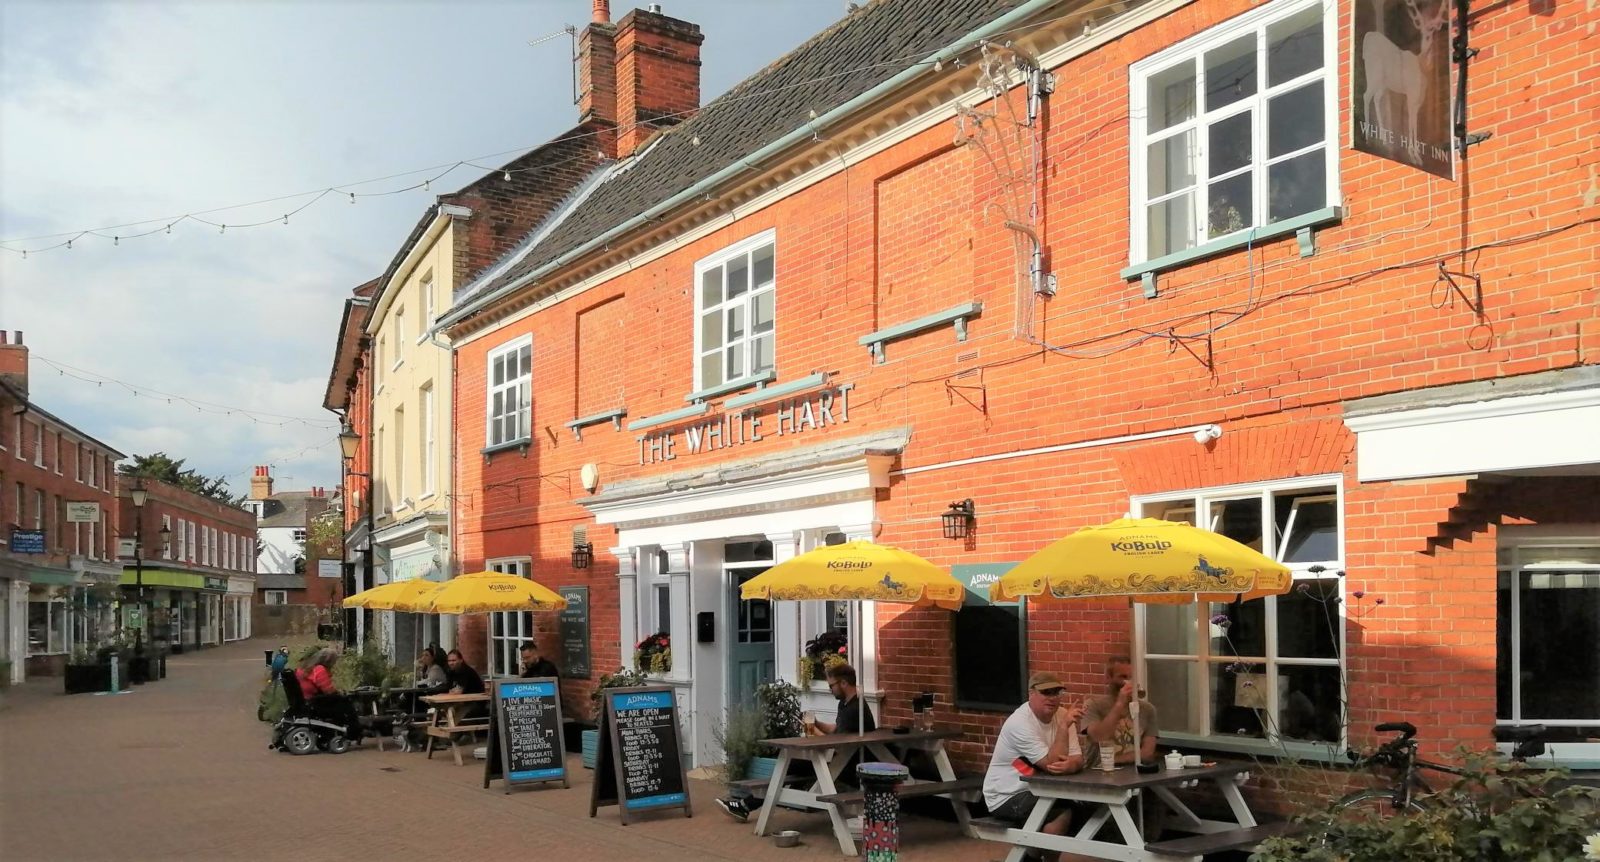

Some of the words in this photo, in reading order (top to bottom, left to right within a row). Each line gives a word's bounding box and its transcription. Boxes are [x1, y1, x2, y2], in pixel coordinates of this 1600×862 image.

[1360, 120, 1394, 144] WHITE
[1400, 136, 1426, 155] HART
[1432, 146, 1448, 162] INN
[636, 430, 676, 466] THE
[685, 408, 762, 454] WHITE
[778, 384, 855, 436] HART
[626, 695, 658, 705] ADNAMS
